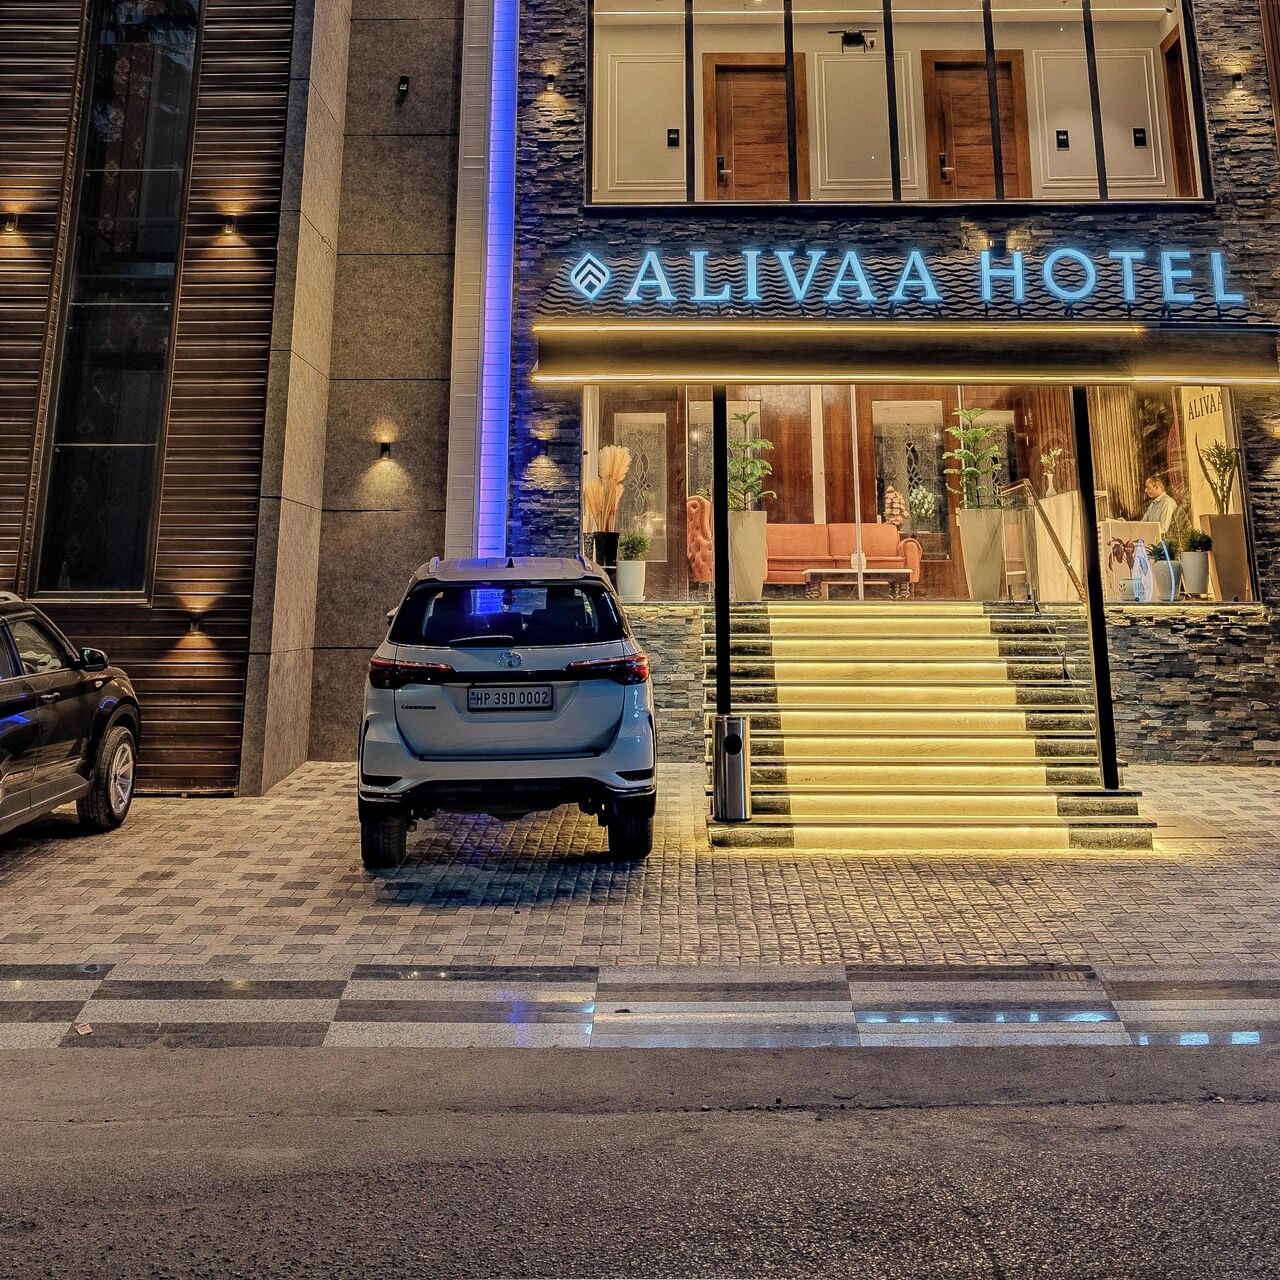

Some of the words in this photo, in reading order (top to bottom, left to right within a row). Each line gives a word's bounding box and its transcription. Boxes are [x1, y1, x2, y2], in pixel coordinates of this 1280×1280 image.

[623, 250, 942, 303] ALIVAA
[980, 248, 1245, 304] HOTEL
[476, 692, 491, 706] HP
[494, 692, 516, 705] 39D
[519, 691, 549, 705] 0002
